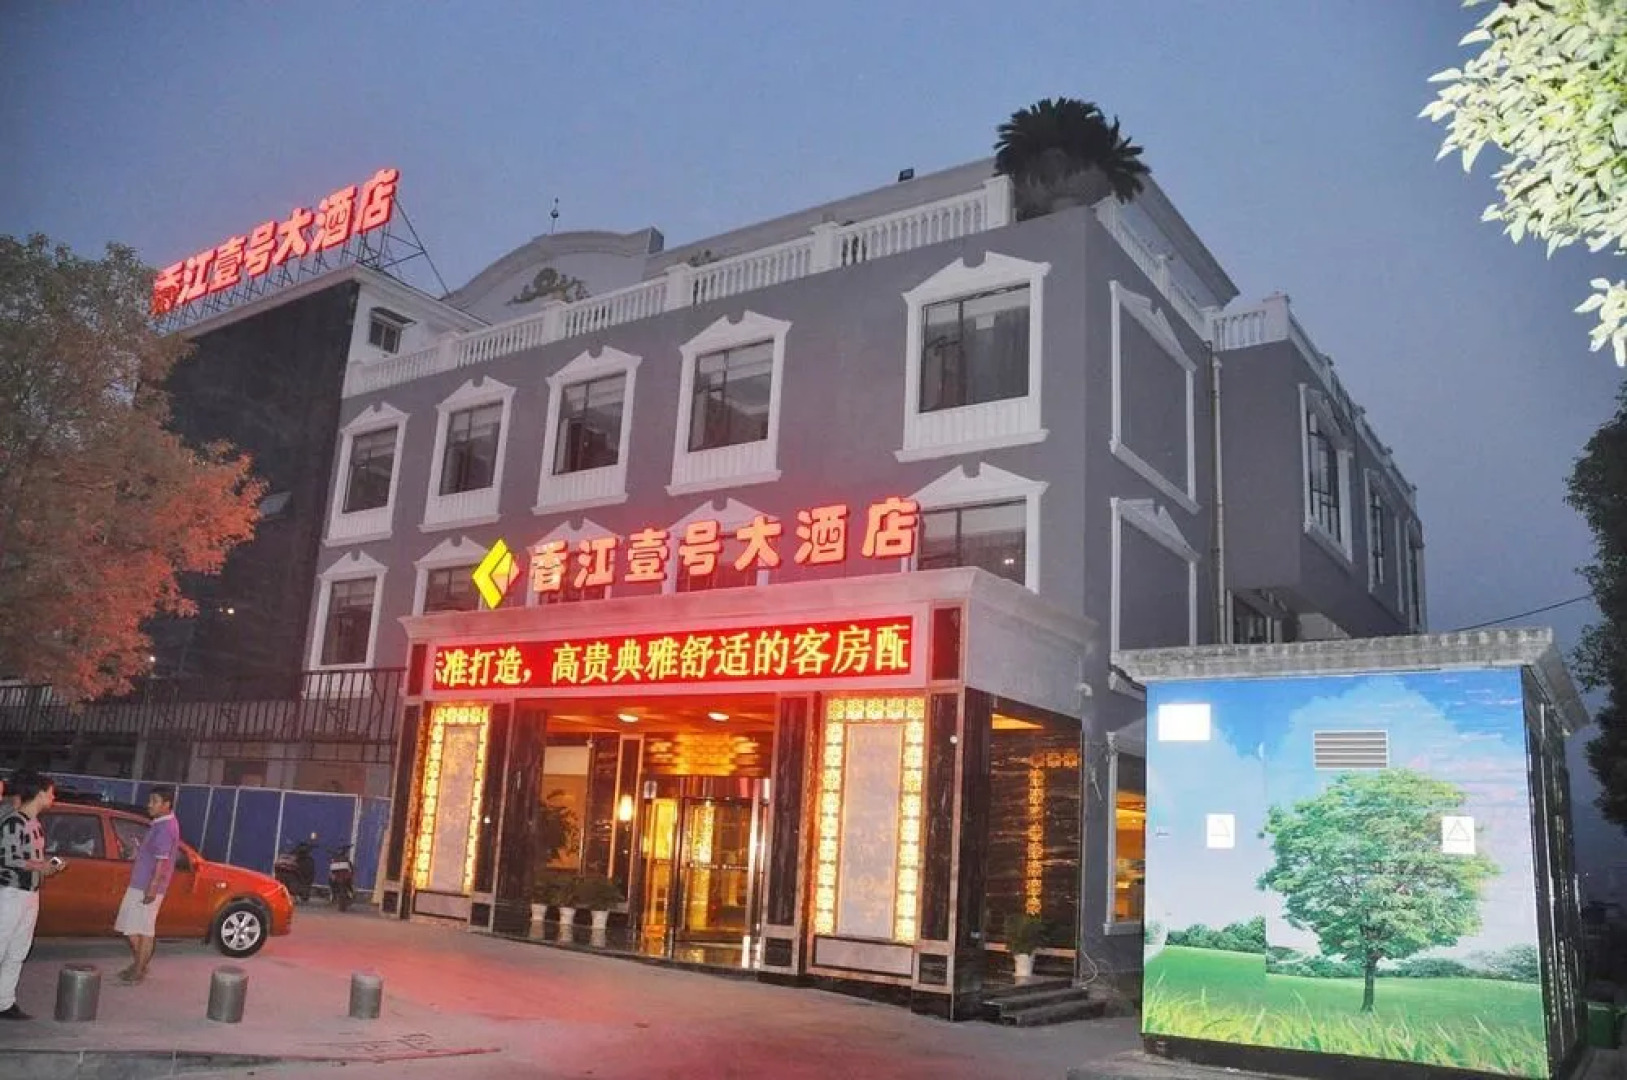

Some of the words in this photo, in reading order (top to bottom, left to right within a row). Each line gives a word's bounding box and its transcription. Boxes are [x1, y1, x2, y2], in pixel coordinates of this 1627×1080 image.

[151, 168, 399, 316] 香江壹号大酒店
[530, 497, 920, 593] 香江壹号大酒店
